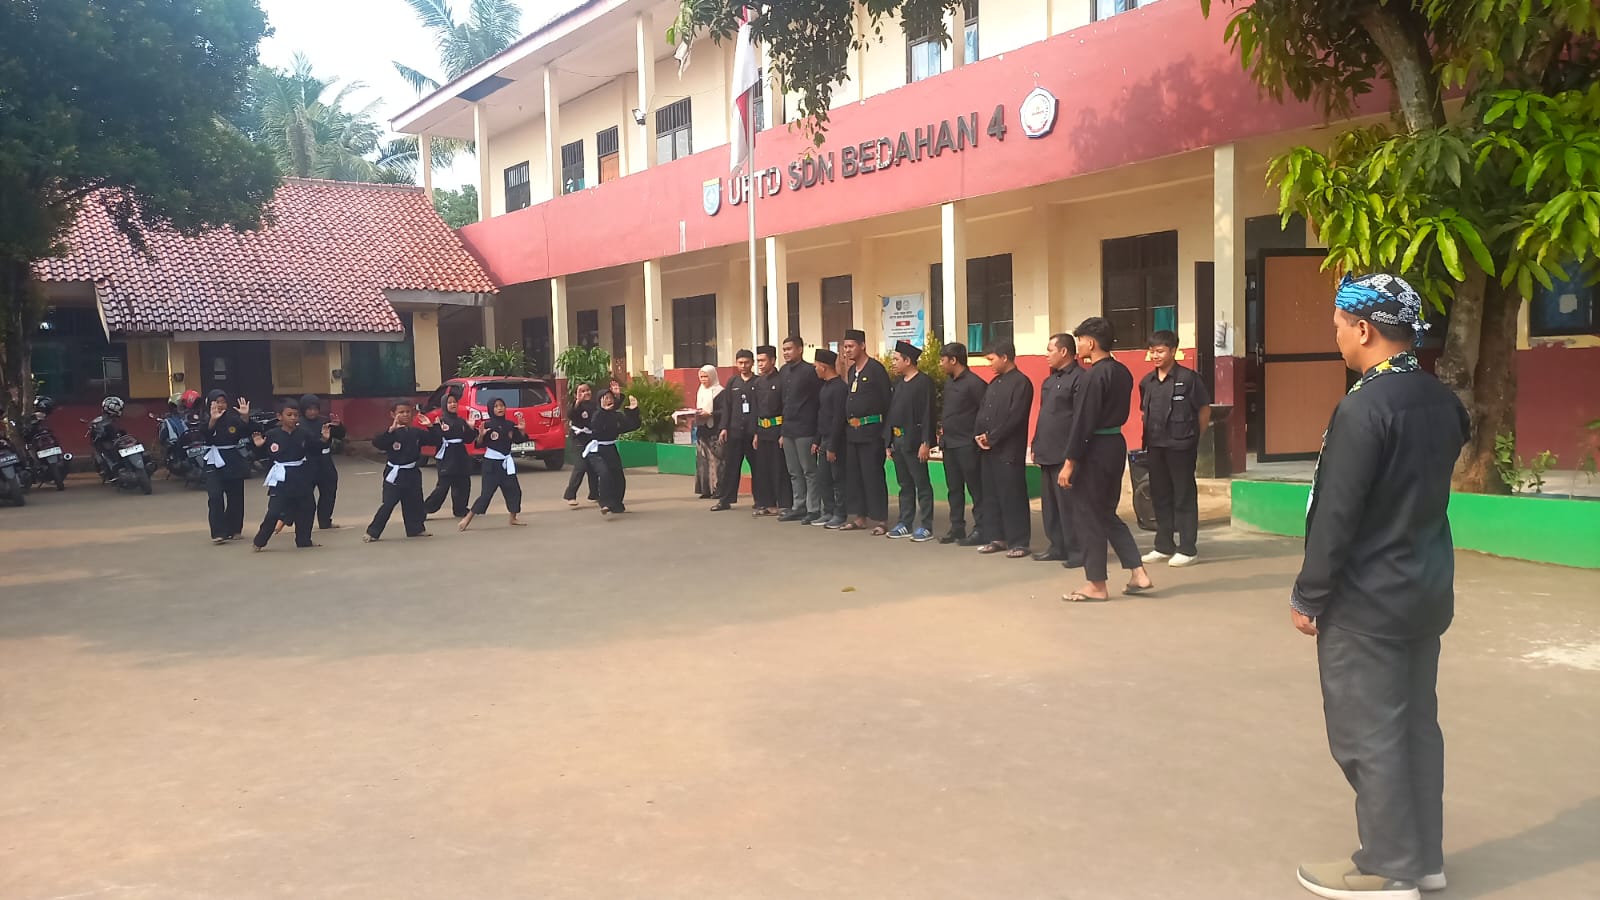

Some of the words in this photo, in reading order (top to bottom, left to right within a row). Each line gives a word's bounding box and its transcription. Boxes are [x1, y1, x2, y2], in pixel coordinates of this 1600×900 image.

[788, 151, 835, 192] SDN
[841, 111, 978, 178] BEDAHAN
[986, 104, 1007, 142] 4
